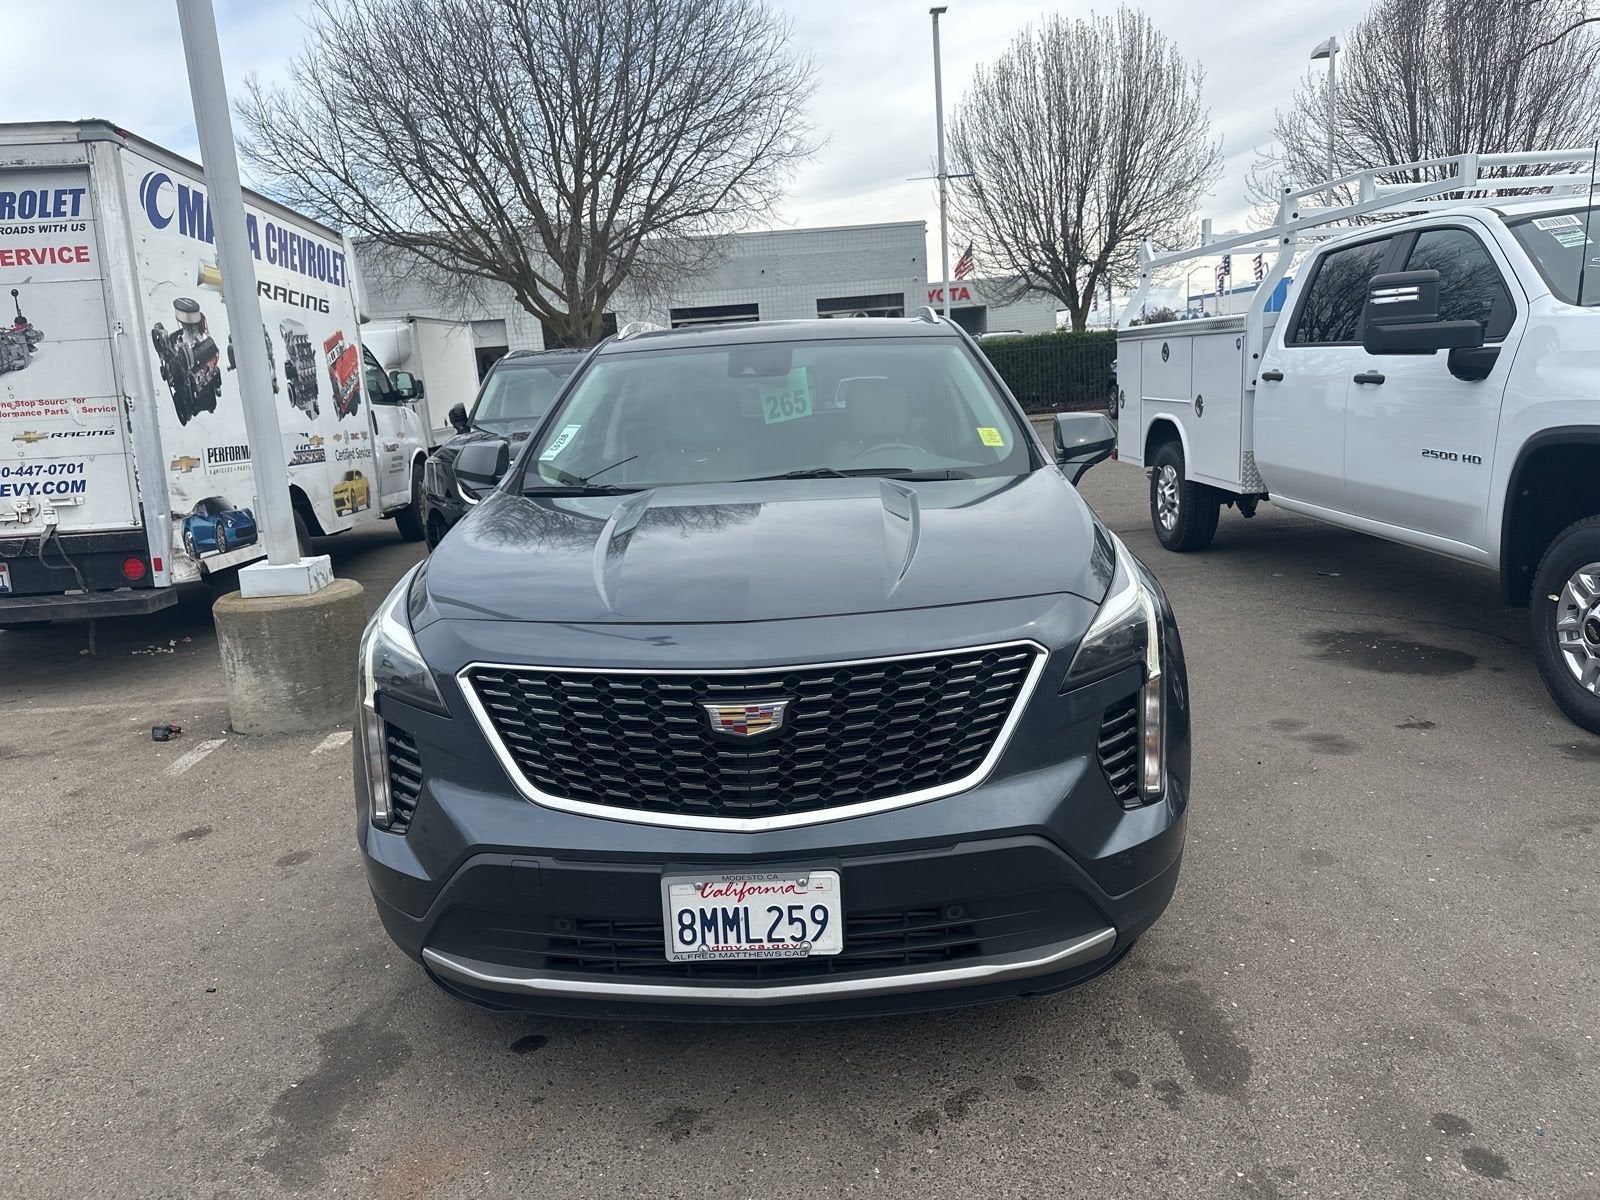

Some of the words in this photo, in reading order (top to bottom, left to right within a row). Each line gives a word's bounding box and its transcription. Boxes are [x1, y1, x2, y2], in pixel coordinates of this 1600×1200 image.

[0, 188, 86, 219] ROLET
[0, 225, 35, 235] ROADS
[38, 224, 68, 233] WITH
[71, 223, 86, 232] US
[0, 246, 90, 266] ERVICE
[265, 221, 346, 288] CHEVROLET
[257, 280, 330, 314] RACING
[15, 400, 35, 408] Stop
[44, 408, 69, 416] Parts
[81, 405, 117, 414] Service
[765, 389, 807, 420] 265
[50, 429, 116, 438] RACING
[1421, 448, 1458, 461] 2500
[1462, 454, 1482, 465] HD
[1, 462, 84, 478] 0-447-0701
[0, 479, 87, 497] EVY.COM
[700, 881, 808, 903] California
[677, 904, 829, 946] 8MML259
[673, 952, 716, 961] ALFRED
[719, 950, 782, 959] MATTHEWS
[711, 943, 800, 951] dmv.ca.gov
